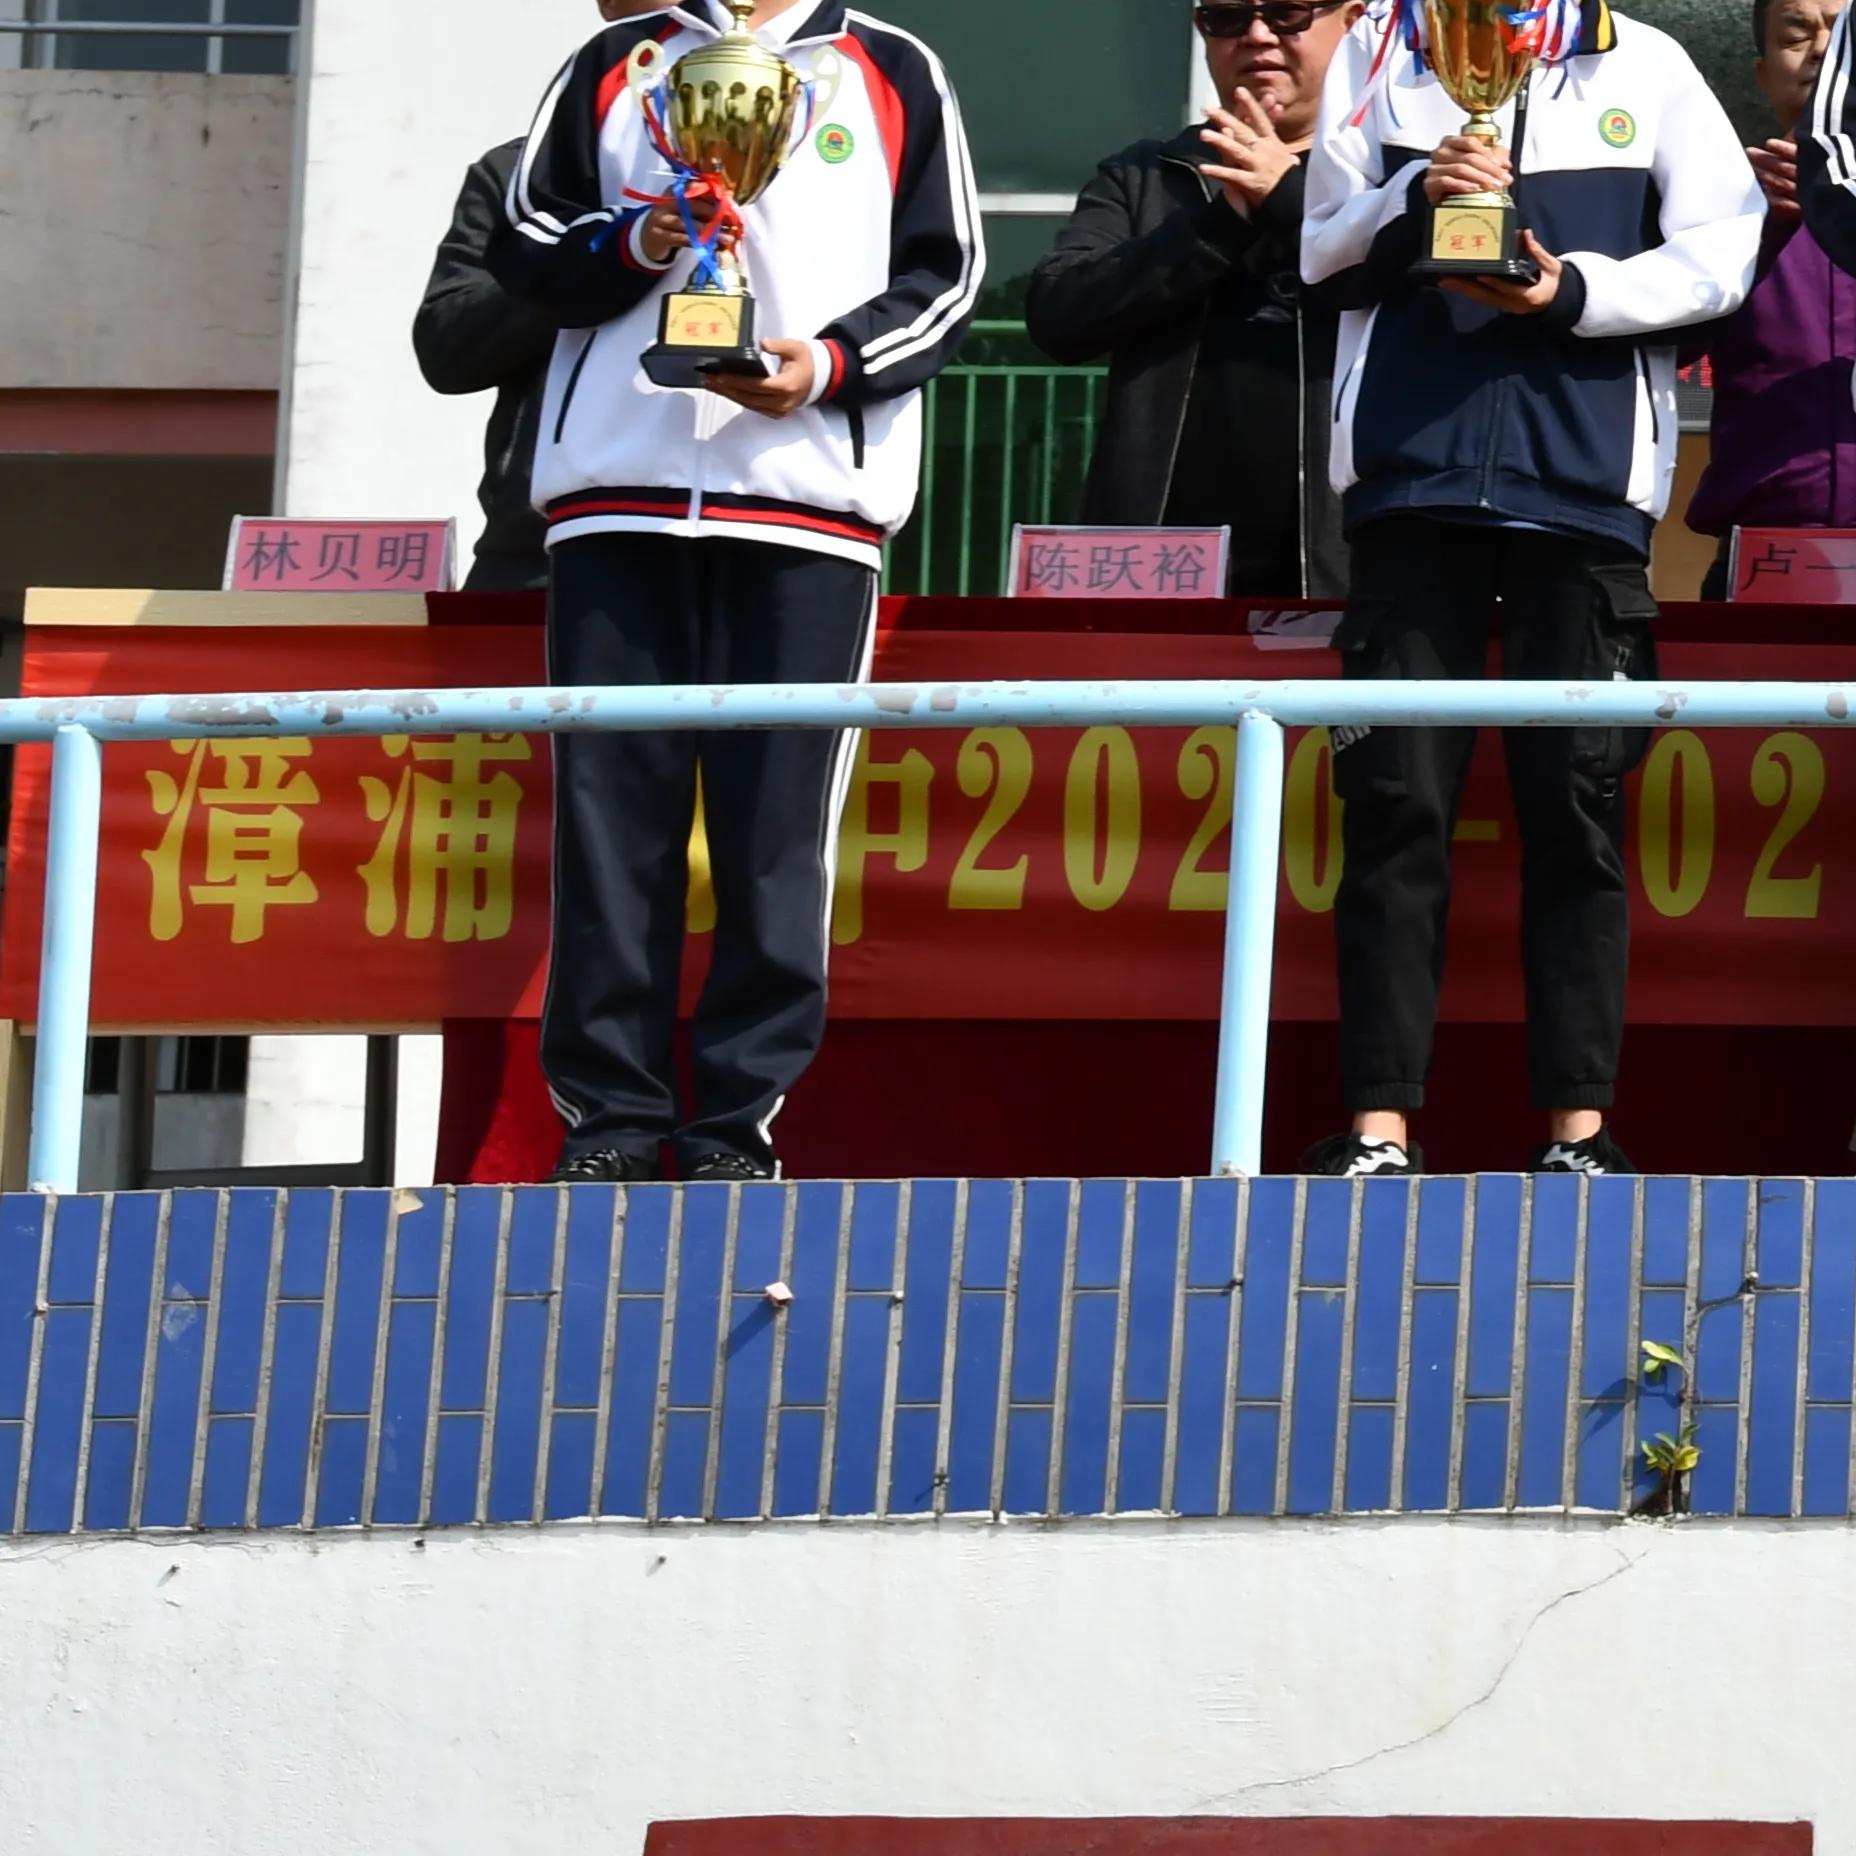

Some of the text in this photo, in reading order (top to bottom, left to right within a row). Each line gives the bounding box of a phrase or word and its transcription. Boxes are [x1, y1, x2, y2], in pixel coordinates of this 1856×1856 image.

[242, 531, 430, 582] 林贝明
[1024, 542, 1207, 592] 陈跃裕
